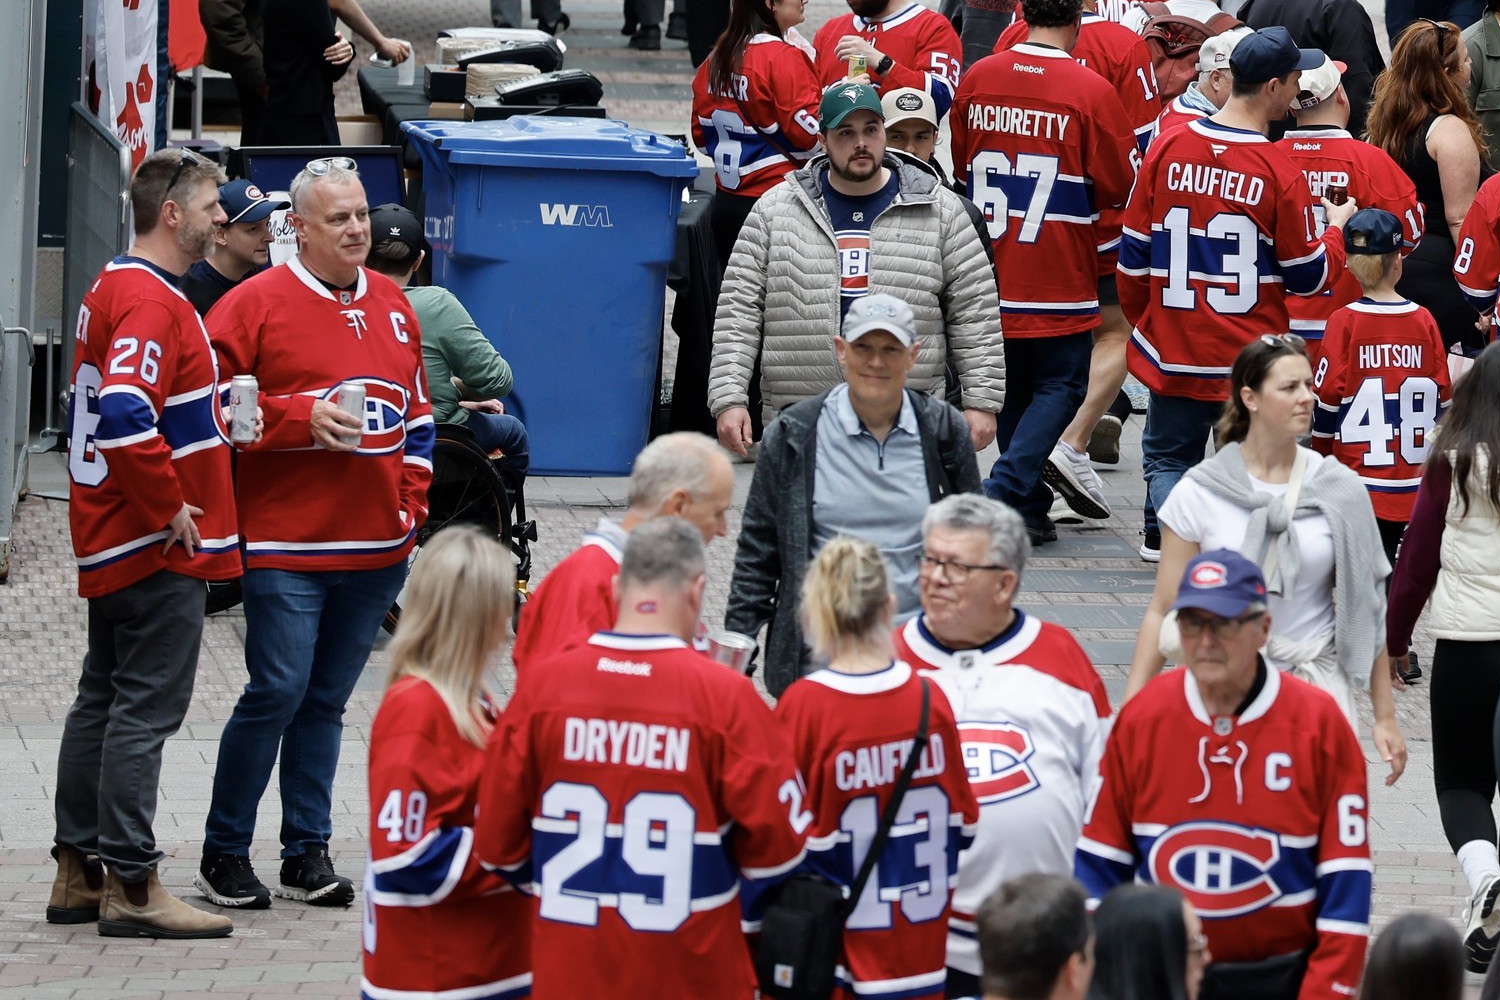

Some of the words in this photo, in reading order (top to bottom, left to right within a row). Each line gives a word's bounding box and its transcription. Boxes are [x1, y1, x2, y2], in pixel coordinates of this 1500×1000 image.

[929, 50, 961, 88] 53
[1012, 62, 1045, 75] Reebok
[967, 102, 1070, 141] PACIORETTY
[710, 108, 744, 190] 6
[1292, 142, 1322, 152] Reebok
[970, 149, 1061, 245] 67
[1166, 161, 1265, 207] CAUFIELD
[538, 202, 611, 228] WM
[1160, 204, 1260, 316] 13
[392, 311, 410, 345] C
[107, 336, 163, 386] 26
[1358, 343, 1423, 371] HUTSON
[1339, 375, 1439, 467] 48
[596, 657, 653, 678] Reebok
[563, 715, 692, 774] DRYDEN
[1263, 751, 1294, 793] C
[376, 787, 429, 845] 48
[1336, 793, 1368, 849] 6
[537, 780, 698, 934] 29
[839, 783, 953, 933] 13
